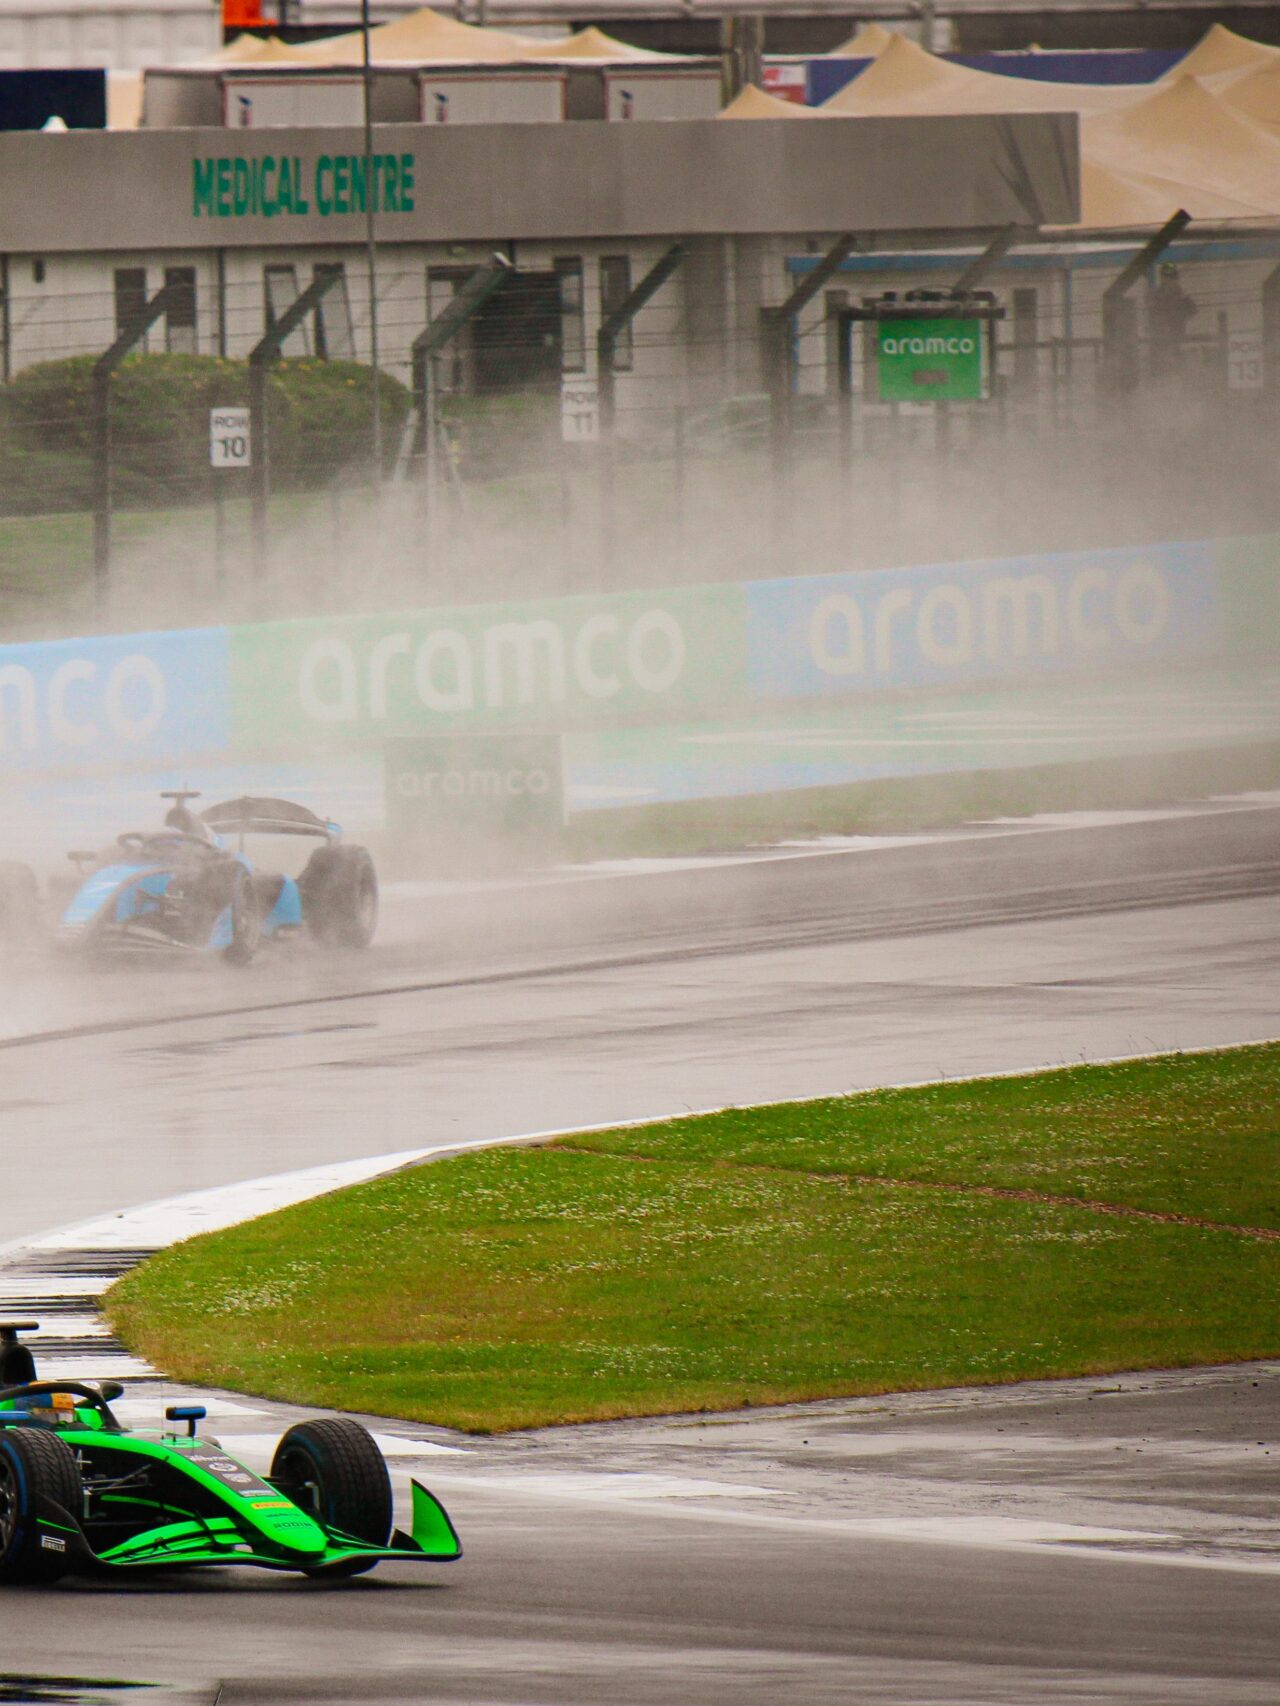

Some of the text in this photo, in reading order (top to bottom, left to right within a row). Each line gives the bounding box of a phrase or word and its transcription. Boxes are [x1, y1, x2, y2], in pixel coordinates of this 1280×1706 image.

[193, 153, 415, 217] MEDICAL CENTRE
[883, 337, 974, 354] aramco
[218, 436, 246, 458] 10
[810, 562, 1169, 676] aramco
[298, 609, 686, 712] aramco
[397, 769, 550, 797] aramco
